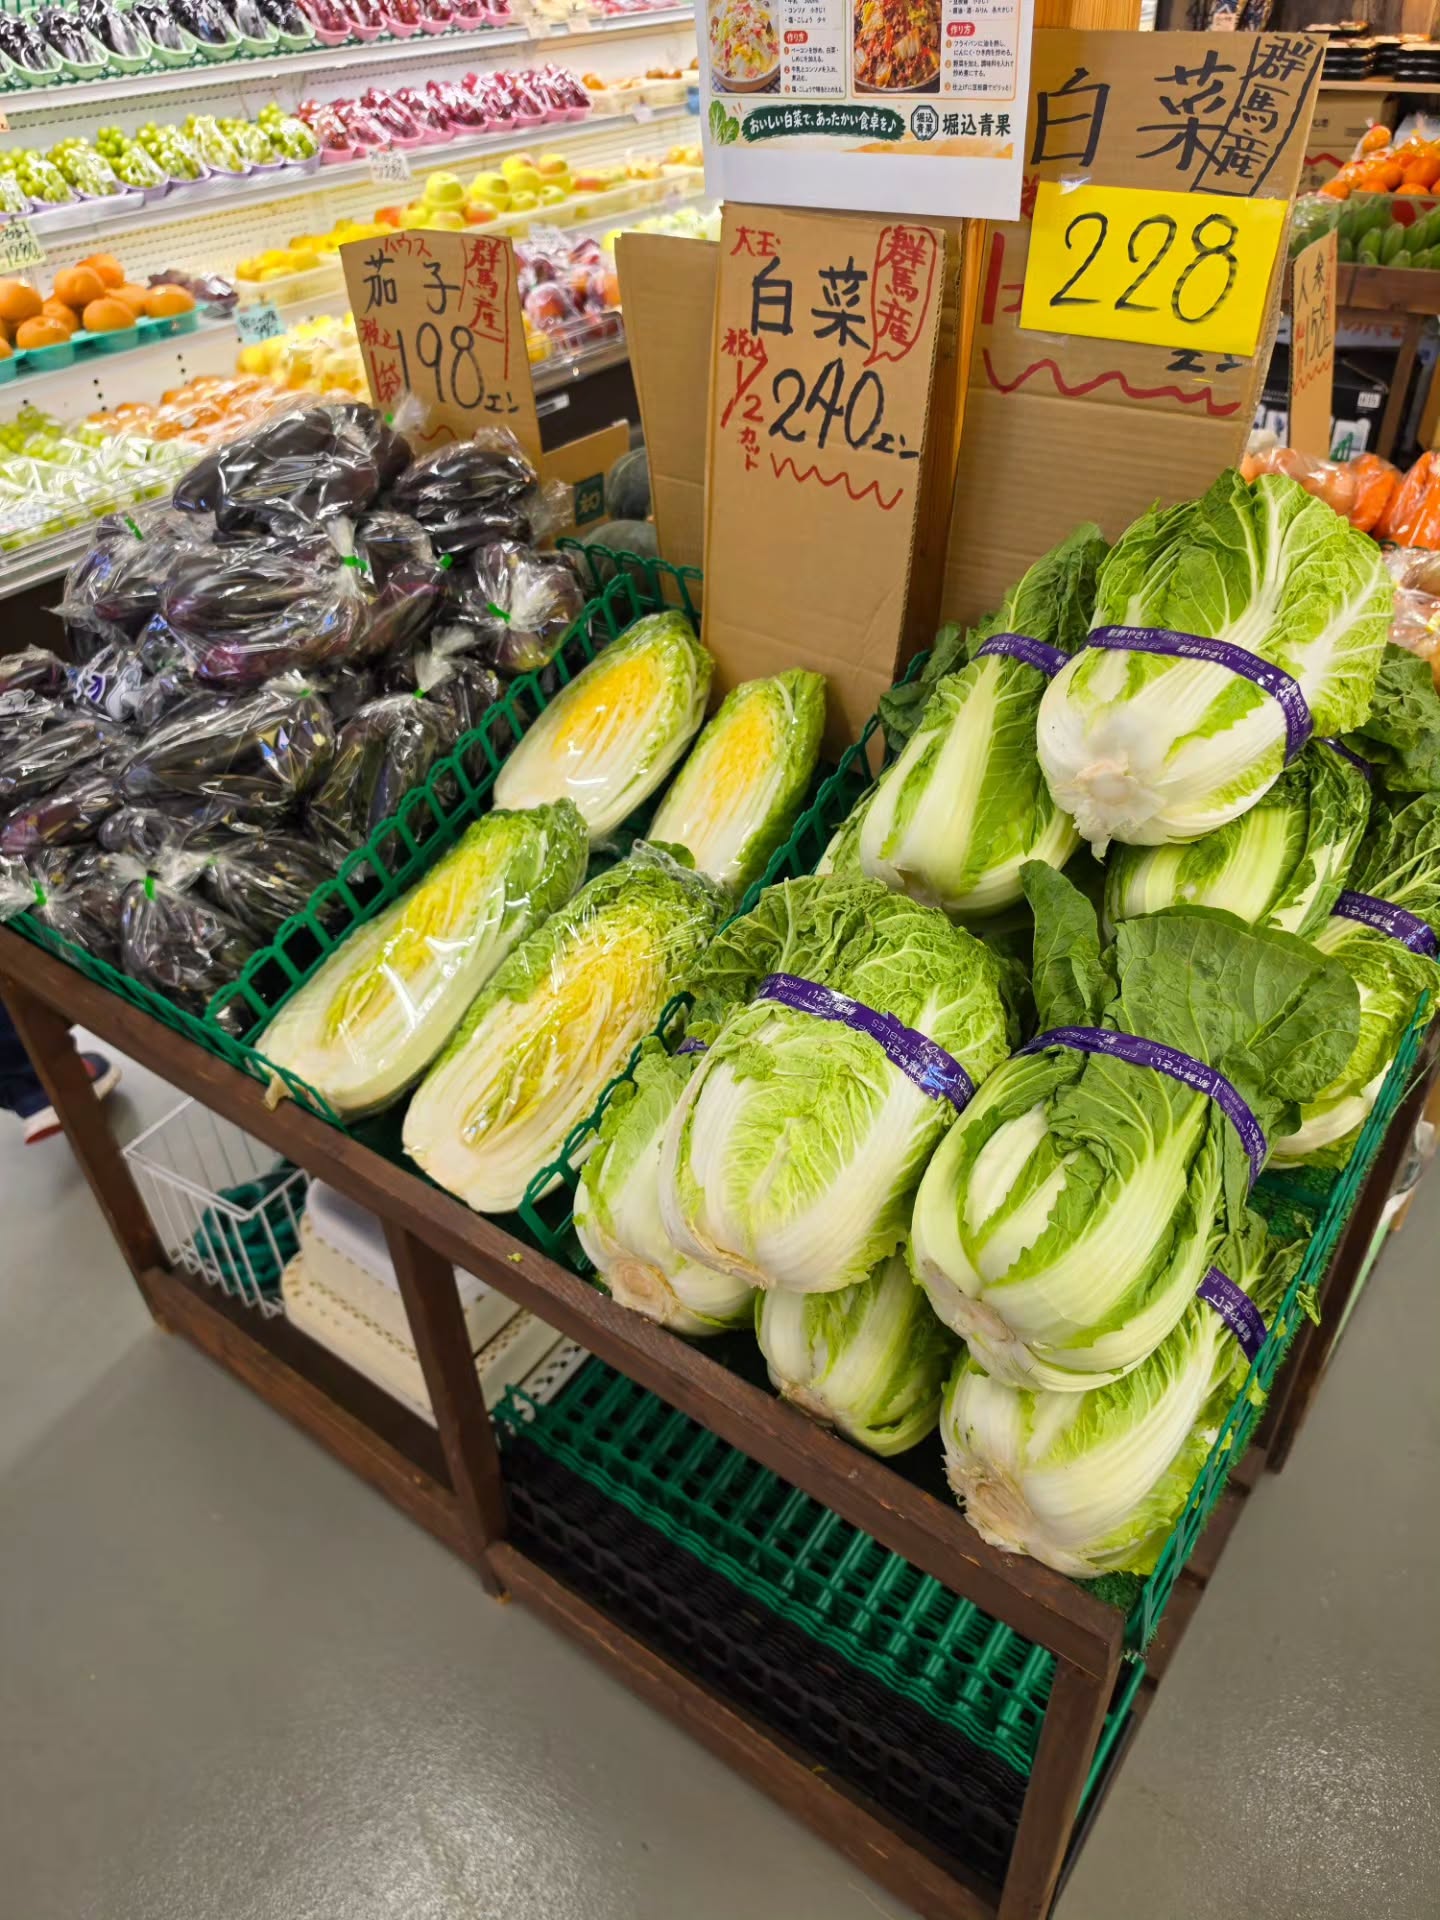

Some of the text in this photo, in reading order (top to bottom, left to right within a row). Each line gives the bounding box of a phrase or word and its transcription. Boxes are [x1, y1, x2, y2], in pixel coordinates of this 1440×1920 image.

[786, 31, 805, 43] 作り方
[950, 24, 972, 36] 作り方
[942, 112, 1011, 138] 堀込青果
[1031, 50, 1236, 170] 白菜
[1217, 36, 1316, 178] 群馬産
[384, 236, 433, 258] ハウス
[730, 226, 781, 257] 大玉
[362, 248, 461, 316] 茄子
[876, 225, 926, 348] 群馬産
[1049, 211, 1240, 323] 228
[464, 238, 504, 337] 群馬産
[751, 256, 871, 350] 白菜
[396, 321, 485, 410] 198
[768, 358, 885, 450] 240
[739, 426, 761, 471] カット
[1101, 638, 1161, 650] VEGETABLES
[1176, 644, 1231, 661] 新鮮やさい
[1199, 641, 1267, 670] VEGETABLES
[1238, 663, 1273, 687] FREH
[1135, 1041, 1213, 1080] VEGETABLES
[1149, 1056, 1211, 1089] 新鮮やさい
